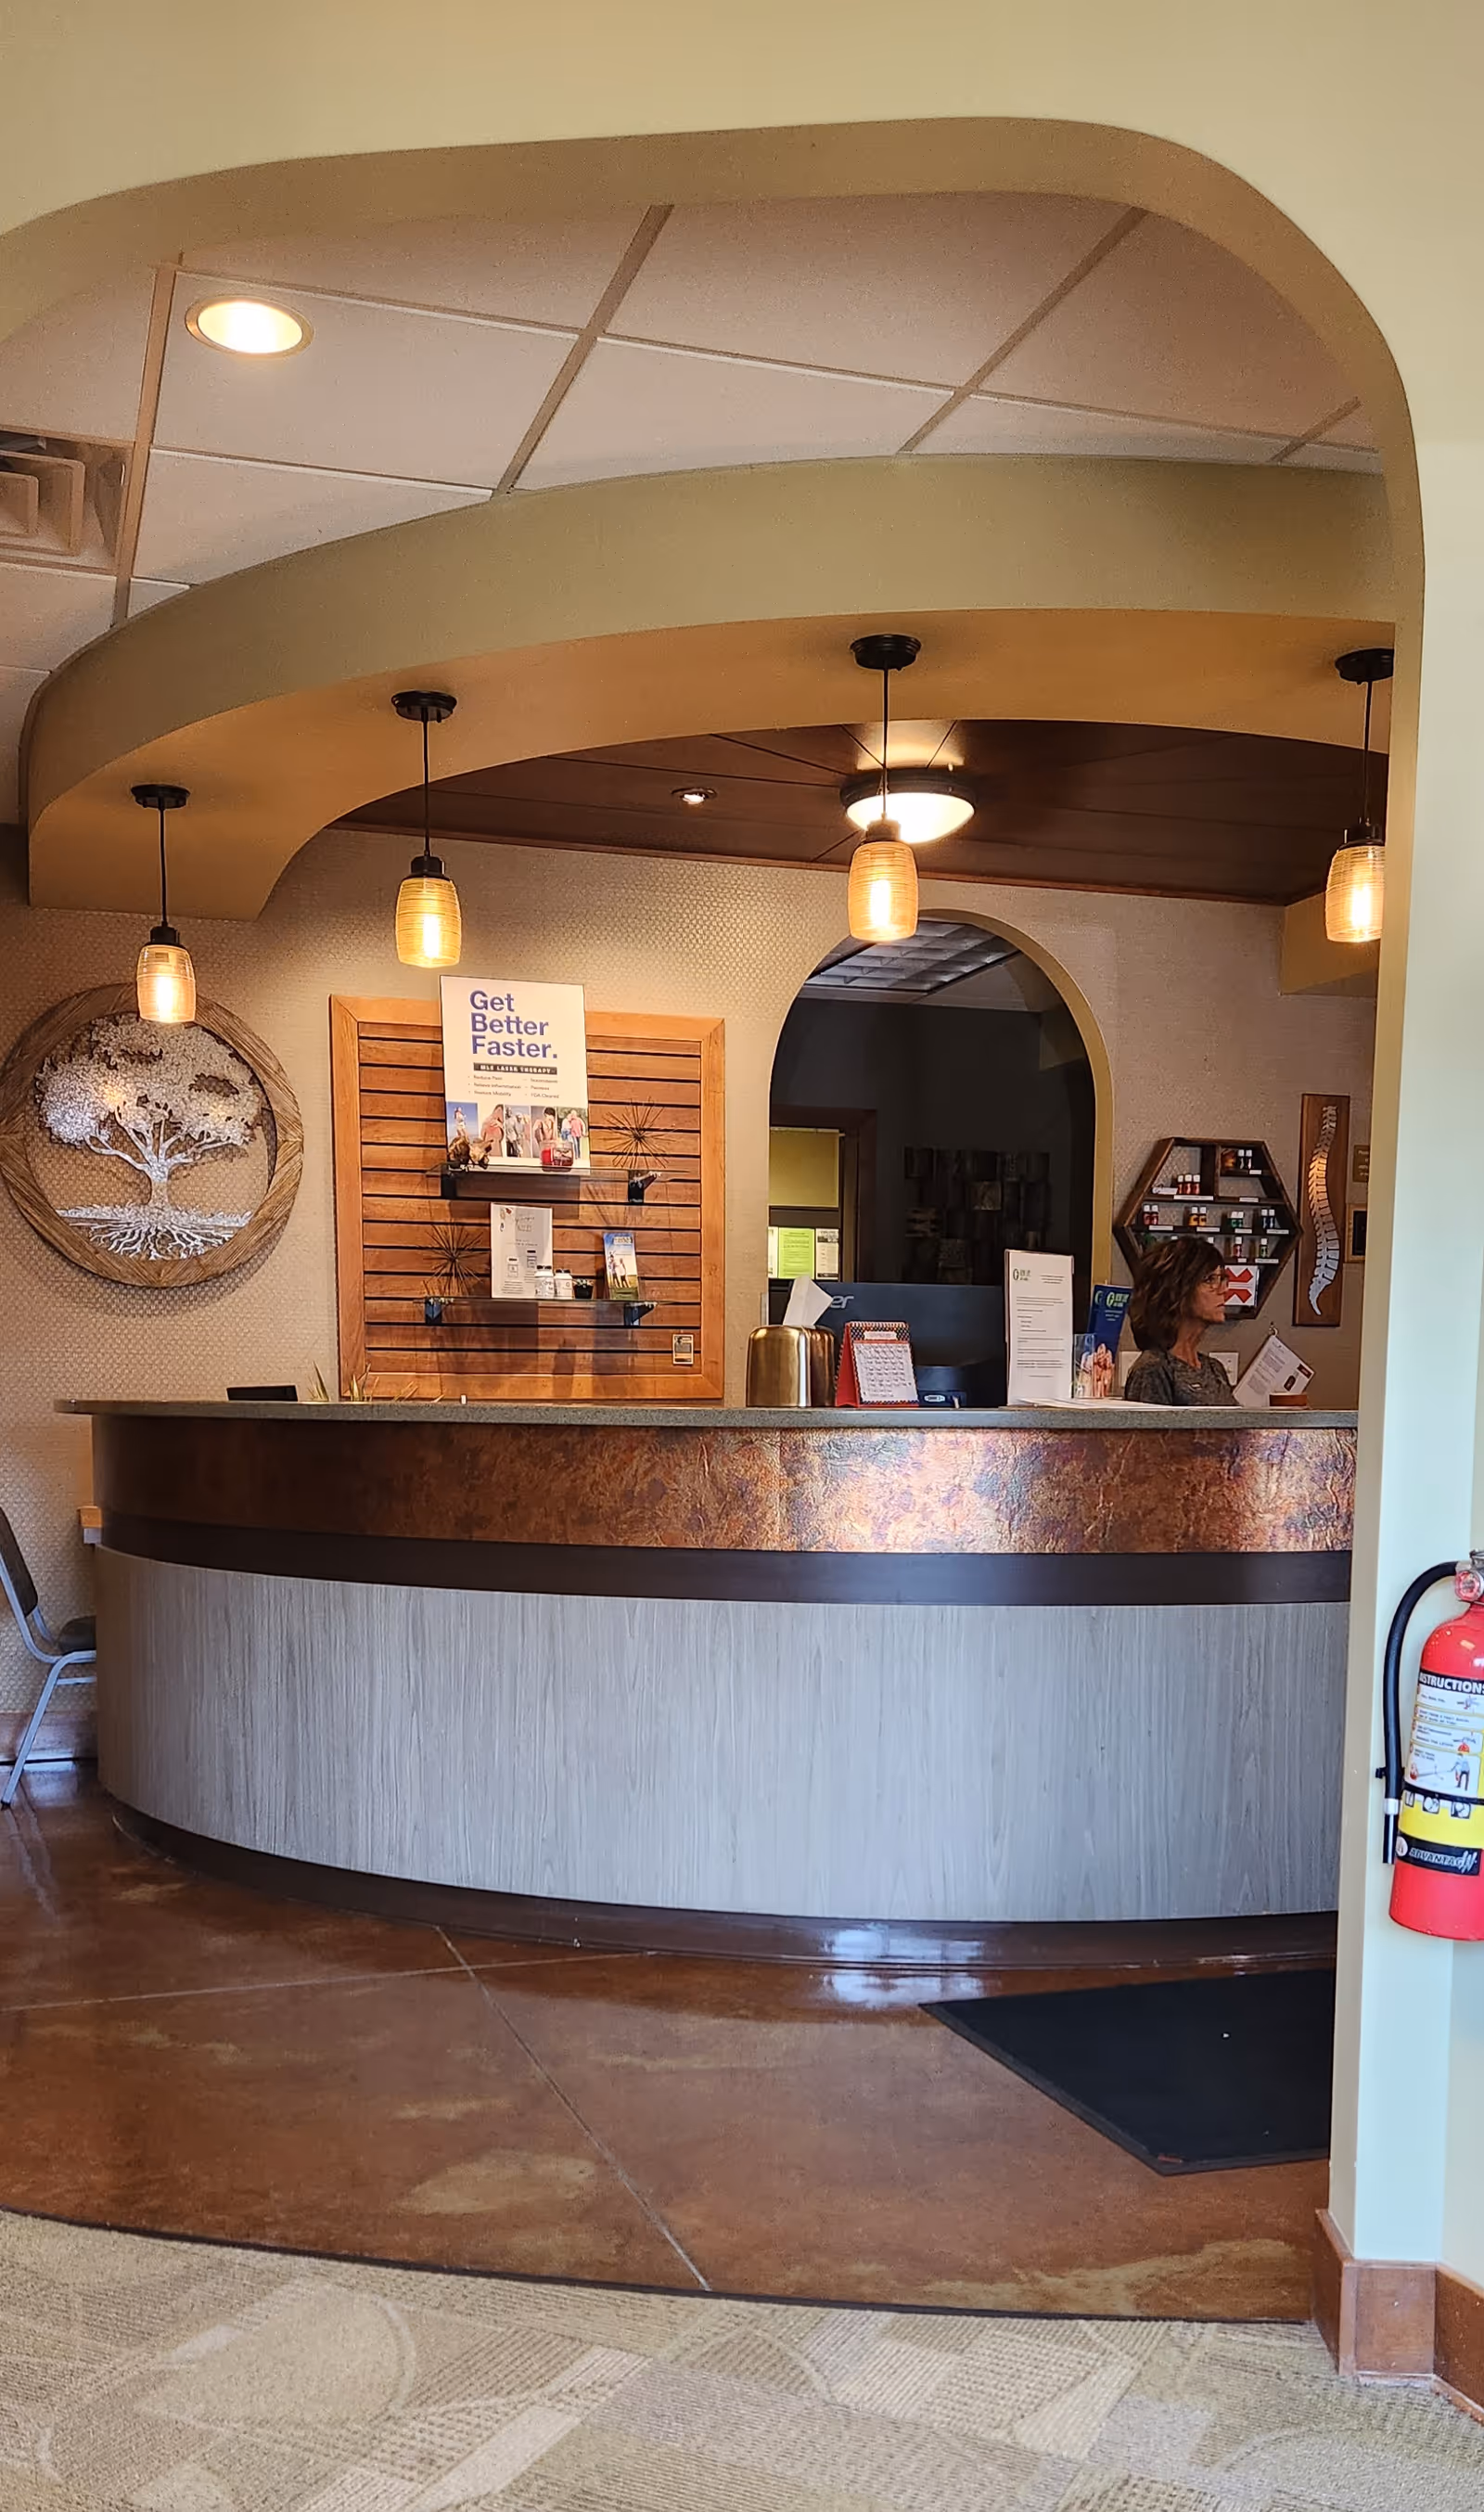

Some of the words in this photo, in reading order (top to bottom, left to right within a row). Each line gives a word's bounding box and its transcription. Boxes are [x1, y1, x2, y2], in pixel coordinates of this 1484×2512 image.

[469, 990, 515, 1012] Get
[471, 1012, 549, 1035] Better
[471, 1034, 557, 1058] Faster.
